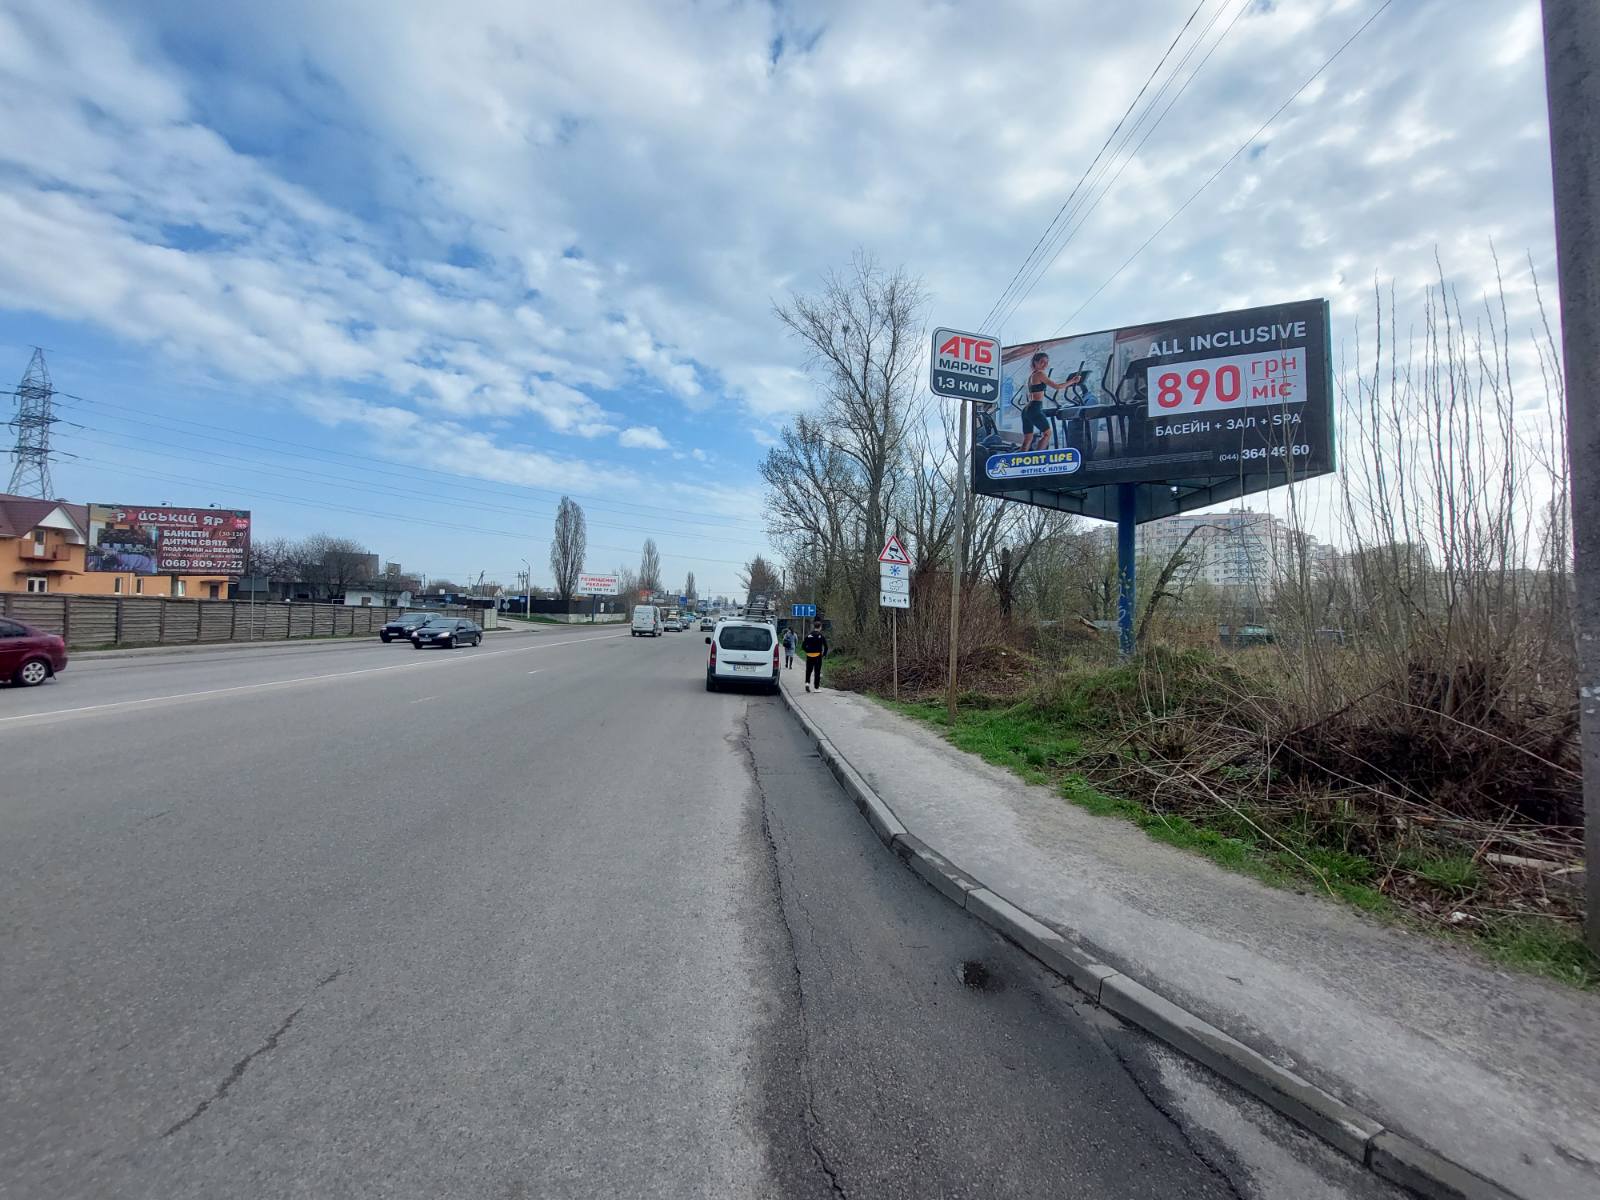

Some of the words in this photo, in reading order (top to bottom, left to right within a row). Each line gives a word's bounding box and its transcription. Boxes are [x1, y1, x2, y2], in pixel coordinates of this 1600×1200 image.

[1147, 338, 1184, 358] ALL
[1190, 321, 1307, 352] INCLUSIVE
[940, 336, 993, 363] АТБ
[939, 359, 994, 376] МАРКЕТ
[937, 376, 956, 389] 1,3
[1157, 364, 1241, 409] 890
[1155, 419, 1211, 437] БАСЕЙН
[1226, 416, 1256, 431] ЗАЛ
[1272, 412, 1302, 426] SPA
[1011, 455, 1046, 467] SPORT
[1219, 454, 1239, 463] (044)
[1241, 447, 1267, 460] 364
[1292, 444, 1310, 456] 60
[163, 529, 209, 538] БАНКЕТИ
[162, 538, 197, 546] ДИТЯЧІ
[199, 539, 228, 547] СВЯТА
[161, 559, 190, 568] (068)
[192, 560, 243, 568] 809-77-22
